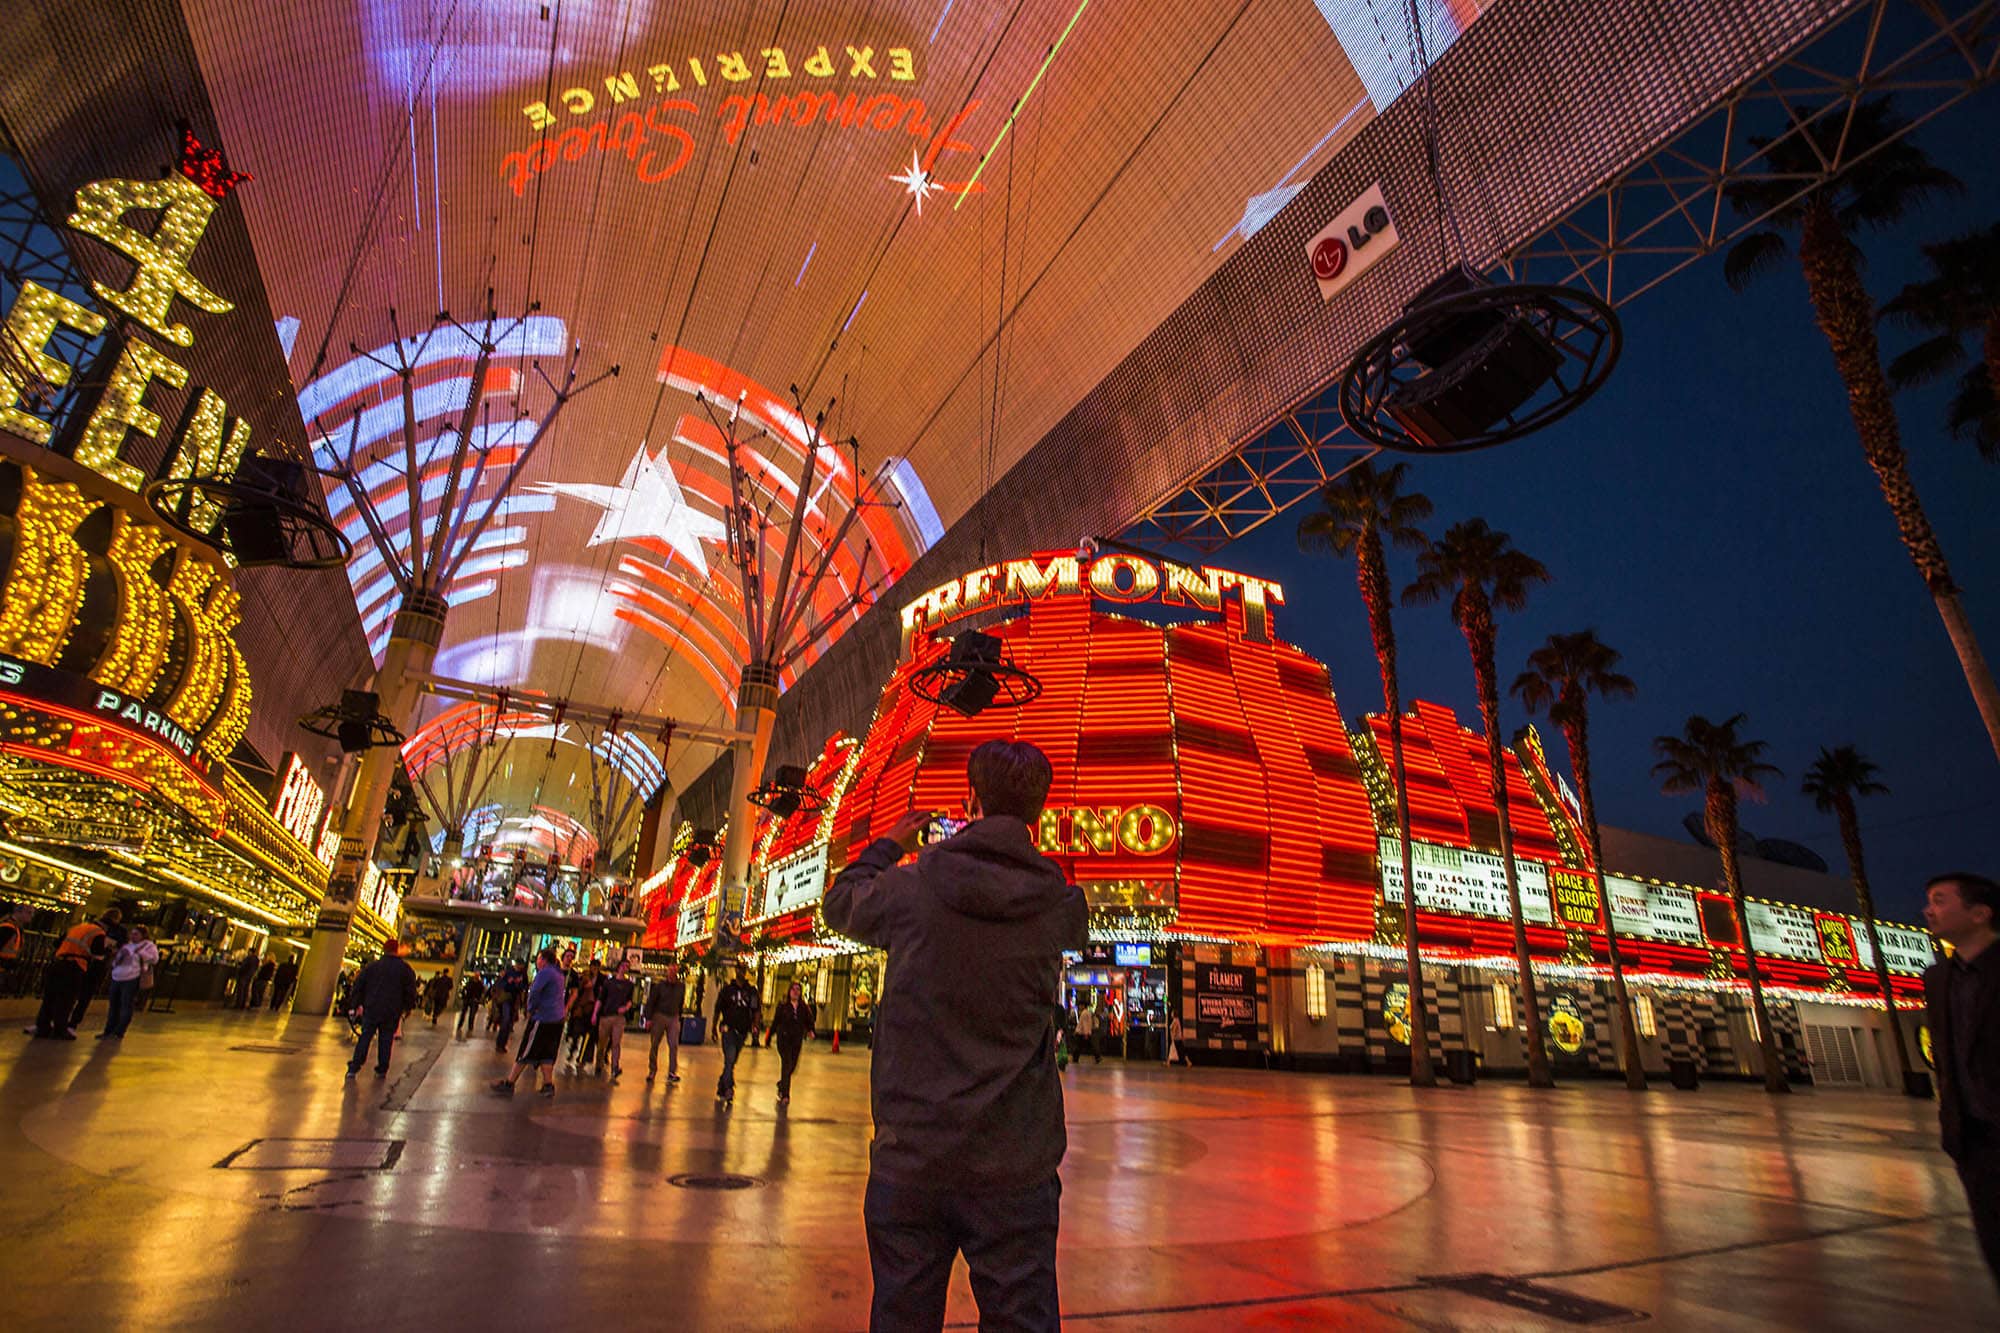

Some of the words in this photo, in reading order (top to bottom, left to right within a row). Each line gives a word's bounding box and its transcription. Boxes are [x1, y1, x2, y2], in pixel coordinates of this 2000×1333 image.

[522, 45, 917, 132] EXPERIENCE
[498, 98, 699, 197] Street
[717, 90, 987, 196] Fremont
[1346, 205, 1391, 251] LG
[900, 552, 1287, 662] FREMONT
[97, 690, 195, 757] PARKING
[1036, 803, 1177, 857] INO
[1463, 853, 1505, 868] BREAKFA
[1555, 871, 1584, 891] RACE
[1587, 877, 1598, 892] &
[1558, 888, 1599, 909] SPORTS
[1566, 904, 1596, 924] BOOK
[1819, 918, 1846, 938] LOOSE
[1825, 940, 1853, 961] SLOTS
[1209, 971, 1243, 988] FILAMENT
